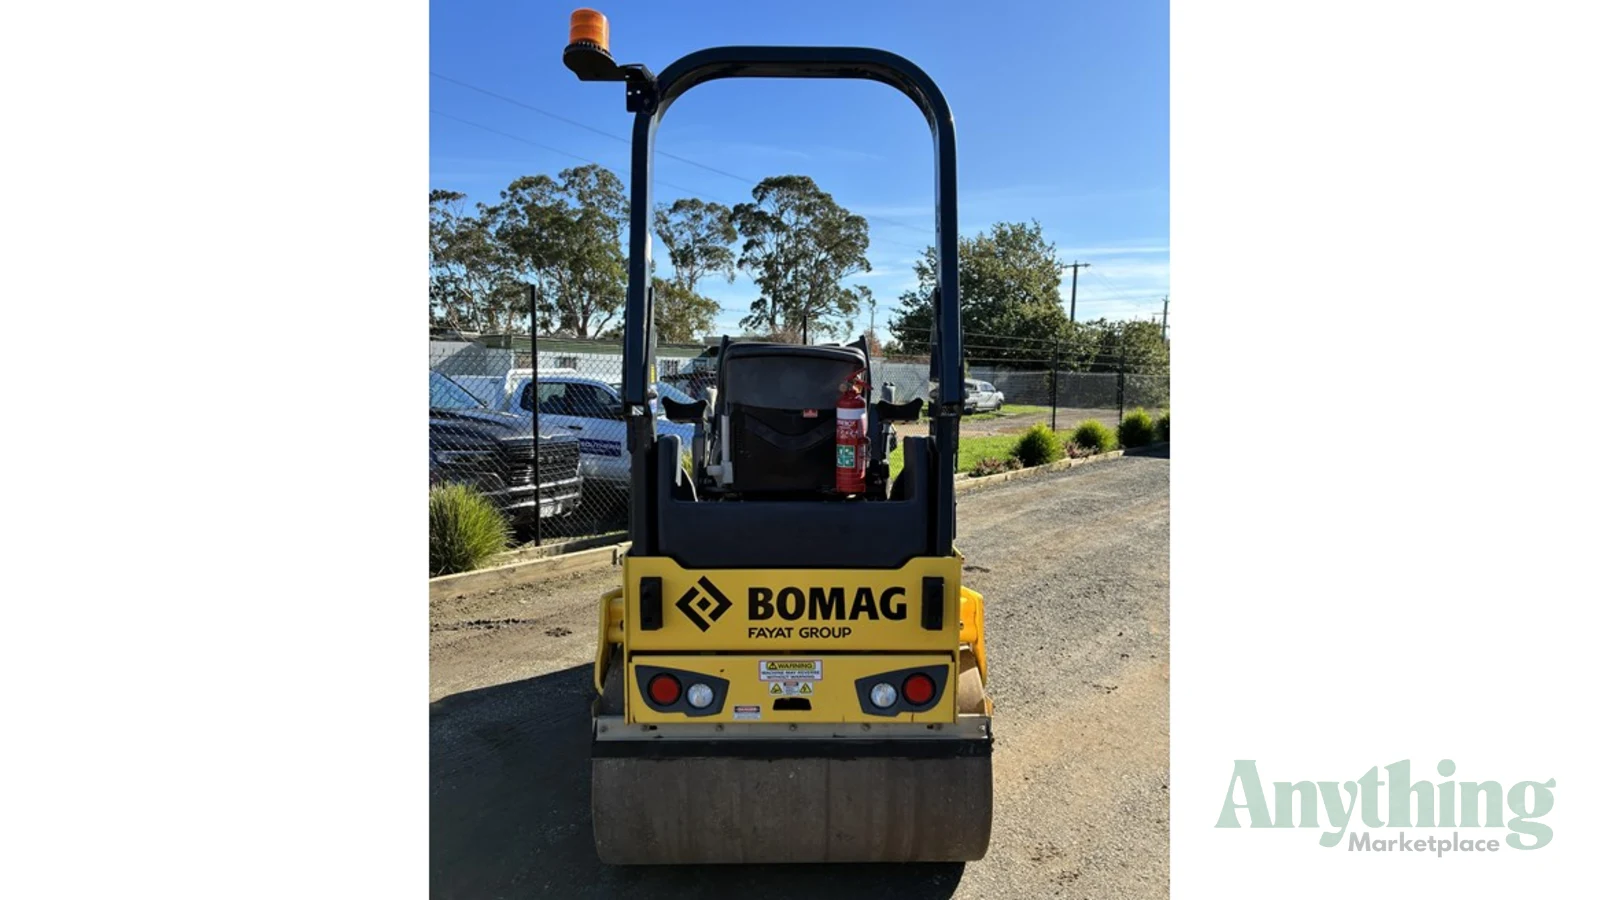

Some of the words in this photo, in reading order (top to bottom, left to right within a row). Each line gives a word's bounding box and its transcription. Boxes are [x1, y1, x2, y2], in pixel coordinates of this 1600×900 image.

[748, 586, 908, 621] BOMAG
[748, 627, 794, 639] FAYAT
[798, 626, 853, 639] GROUP
